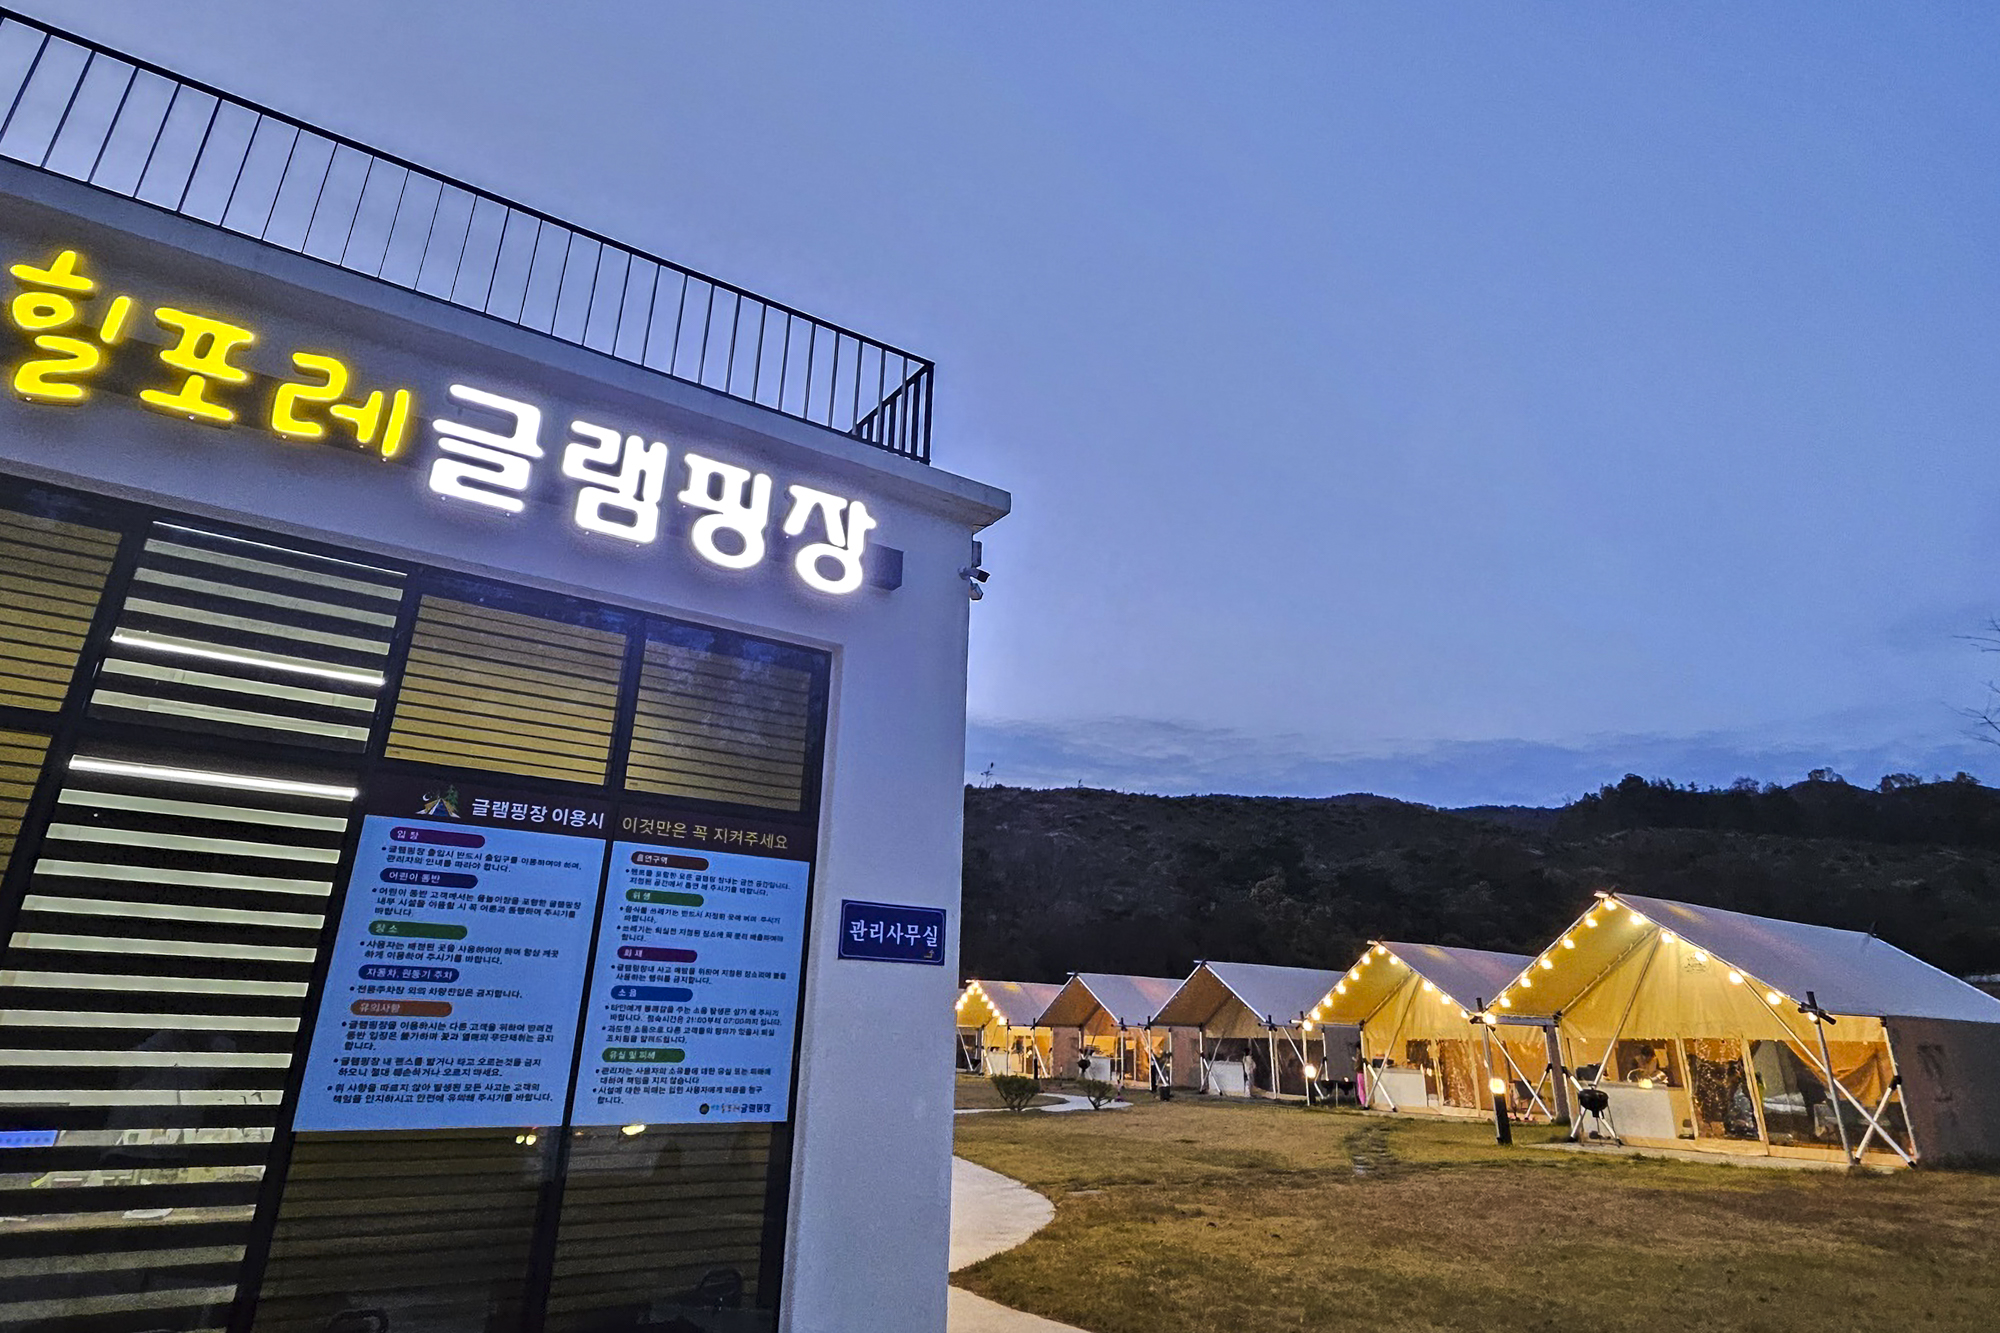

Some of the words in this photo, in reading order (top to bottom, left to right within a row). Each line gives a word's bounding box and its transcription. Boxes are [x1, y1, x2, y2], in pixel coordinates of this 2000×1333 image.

[9, 249, 412, 458] 힐포레
[429, 383, 877, 595] 글램핑장
[472, 798, 548, 823] 글램핑장
[552, 808, 605, 830] 이용시
[622, 816, 688, 839] 이것만은
[692, 824, 708, 841] 꼭
[713, 827, 788, 850] 지켜주세요
[389, 872, 418, 882] 어린이
[849, 919, 938, 947] 관리사무실
[364, 950, 384, 959] 하게
[465, 955, 502, 965] 바랍니다.
[457, 945, 502, 955] 사용하여야
[476, 989, 522, 999] 금지합니다.
[338, 1067, 368, 1077] 하오니
